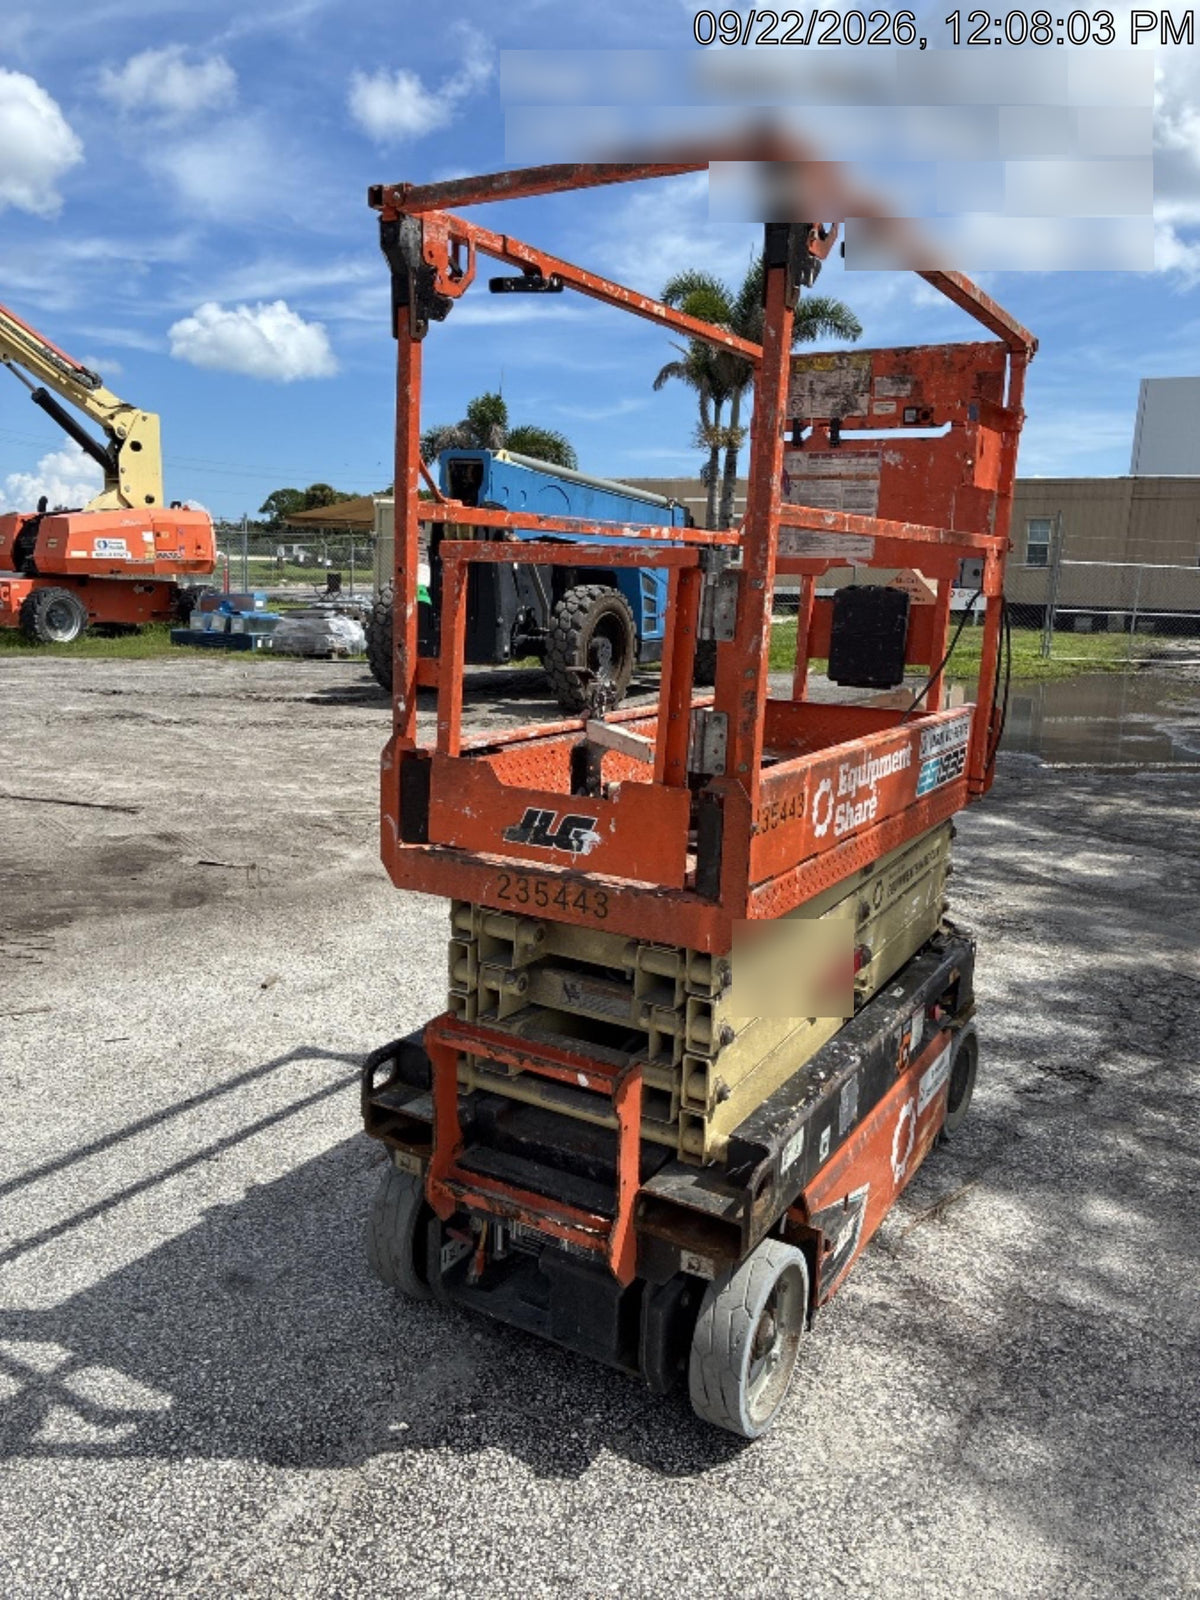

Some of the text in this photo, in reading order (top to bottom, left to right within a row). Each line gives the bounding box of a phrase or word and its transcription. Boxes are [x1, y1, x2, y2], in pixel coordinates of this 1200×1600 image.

[837, 741, 912, 798] Equipment
[503, 806, 600, 854] JLG
[834, 794, 878, 837] Share
[497, 874, 609, 919] 235443
